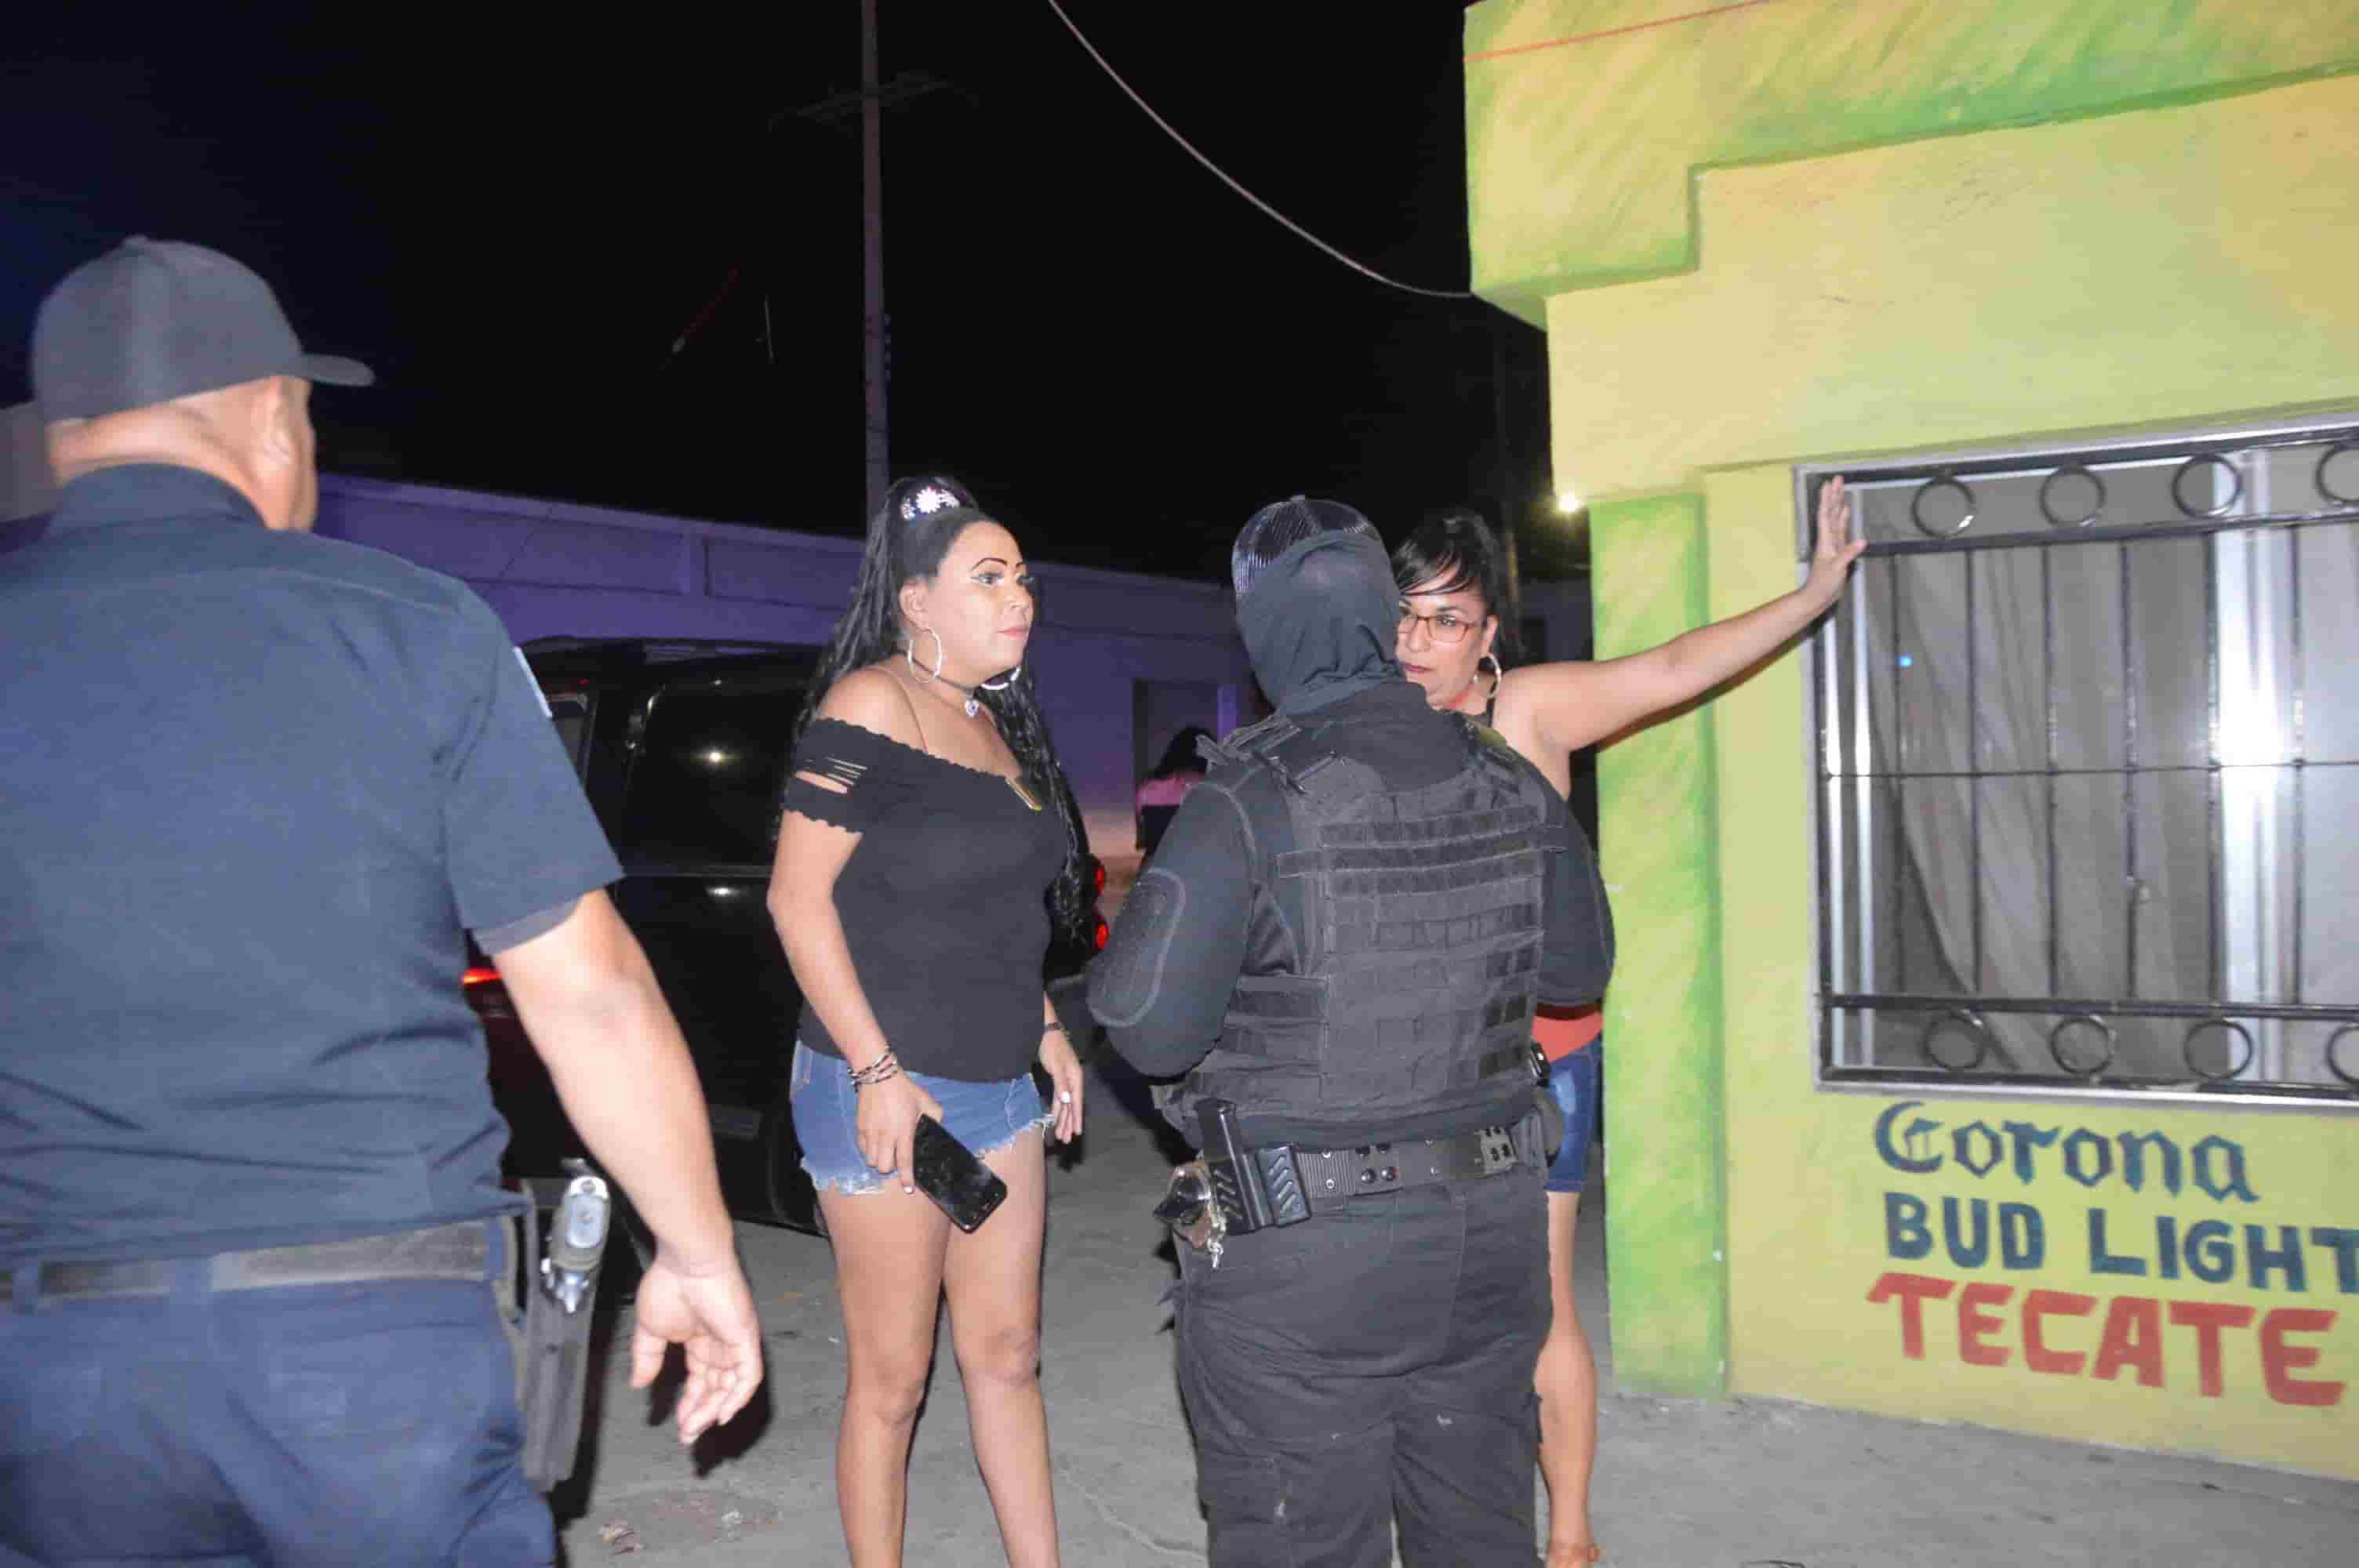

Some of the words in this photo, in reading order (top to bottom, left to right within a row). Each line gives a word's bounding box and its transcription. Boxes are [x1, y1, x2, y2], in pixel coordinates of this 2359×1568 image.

[1873, 1099, 2262, 1203] Corona
[1884, 1191, 2046, 1271] BUD
[2087, 1207, 2359, 1295] LIGHT
[1865, 1272, 2347, 1407] TECATE
